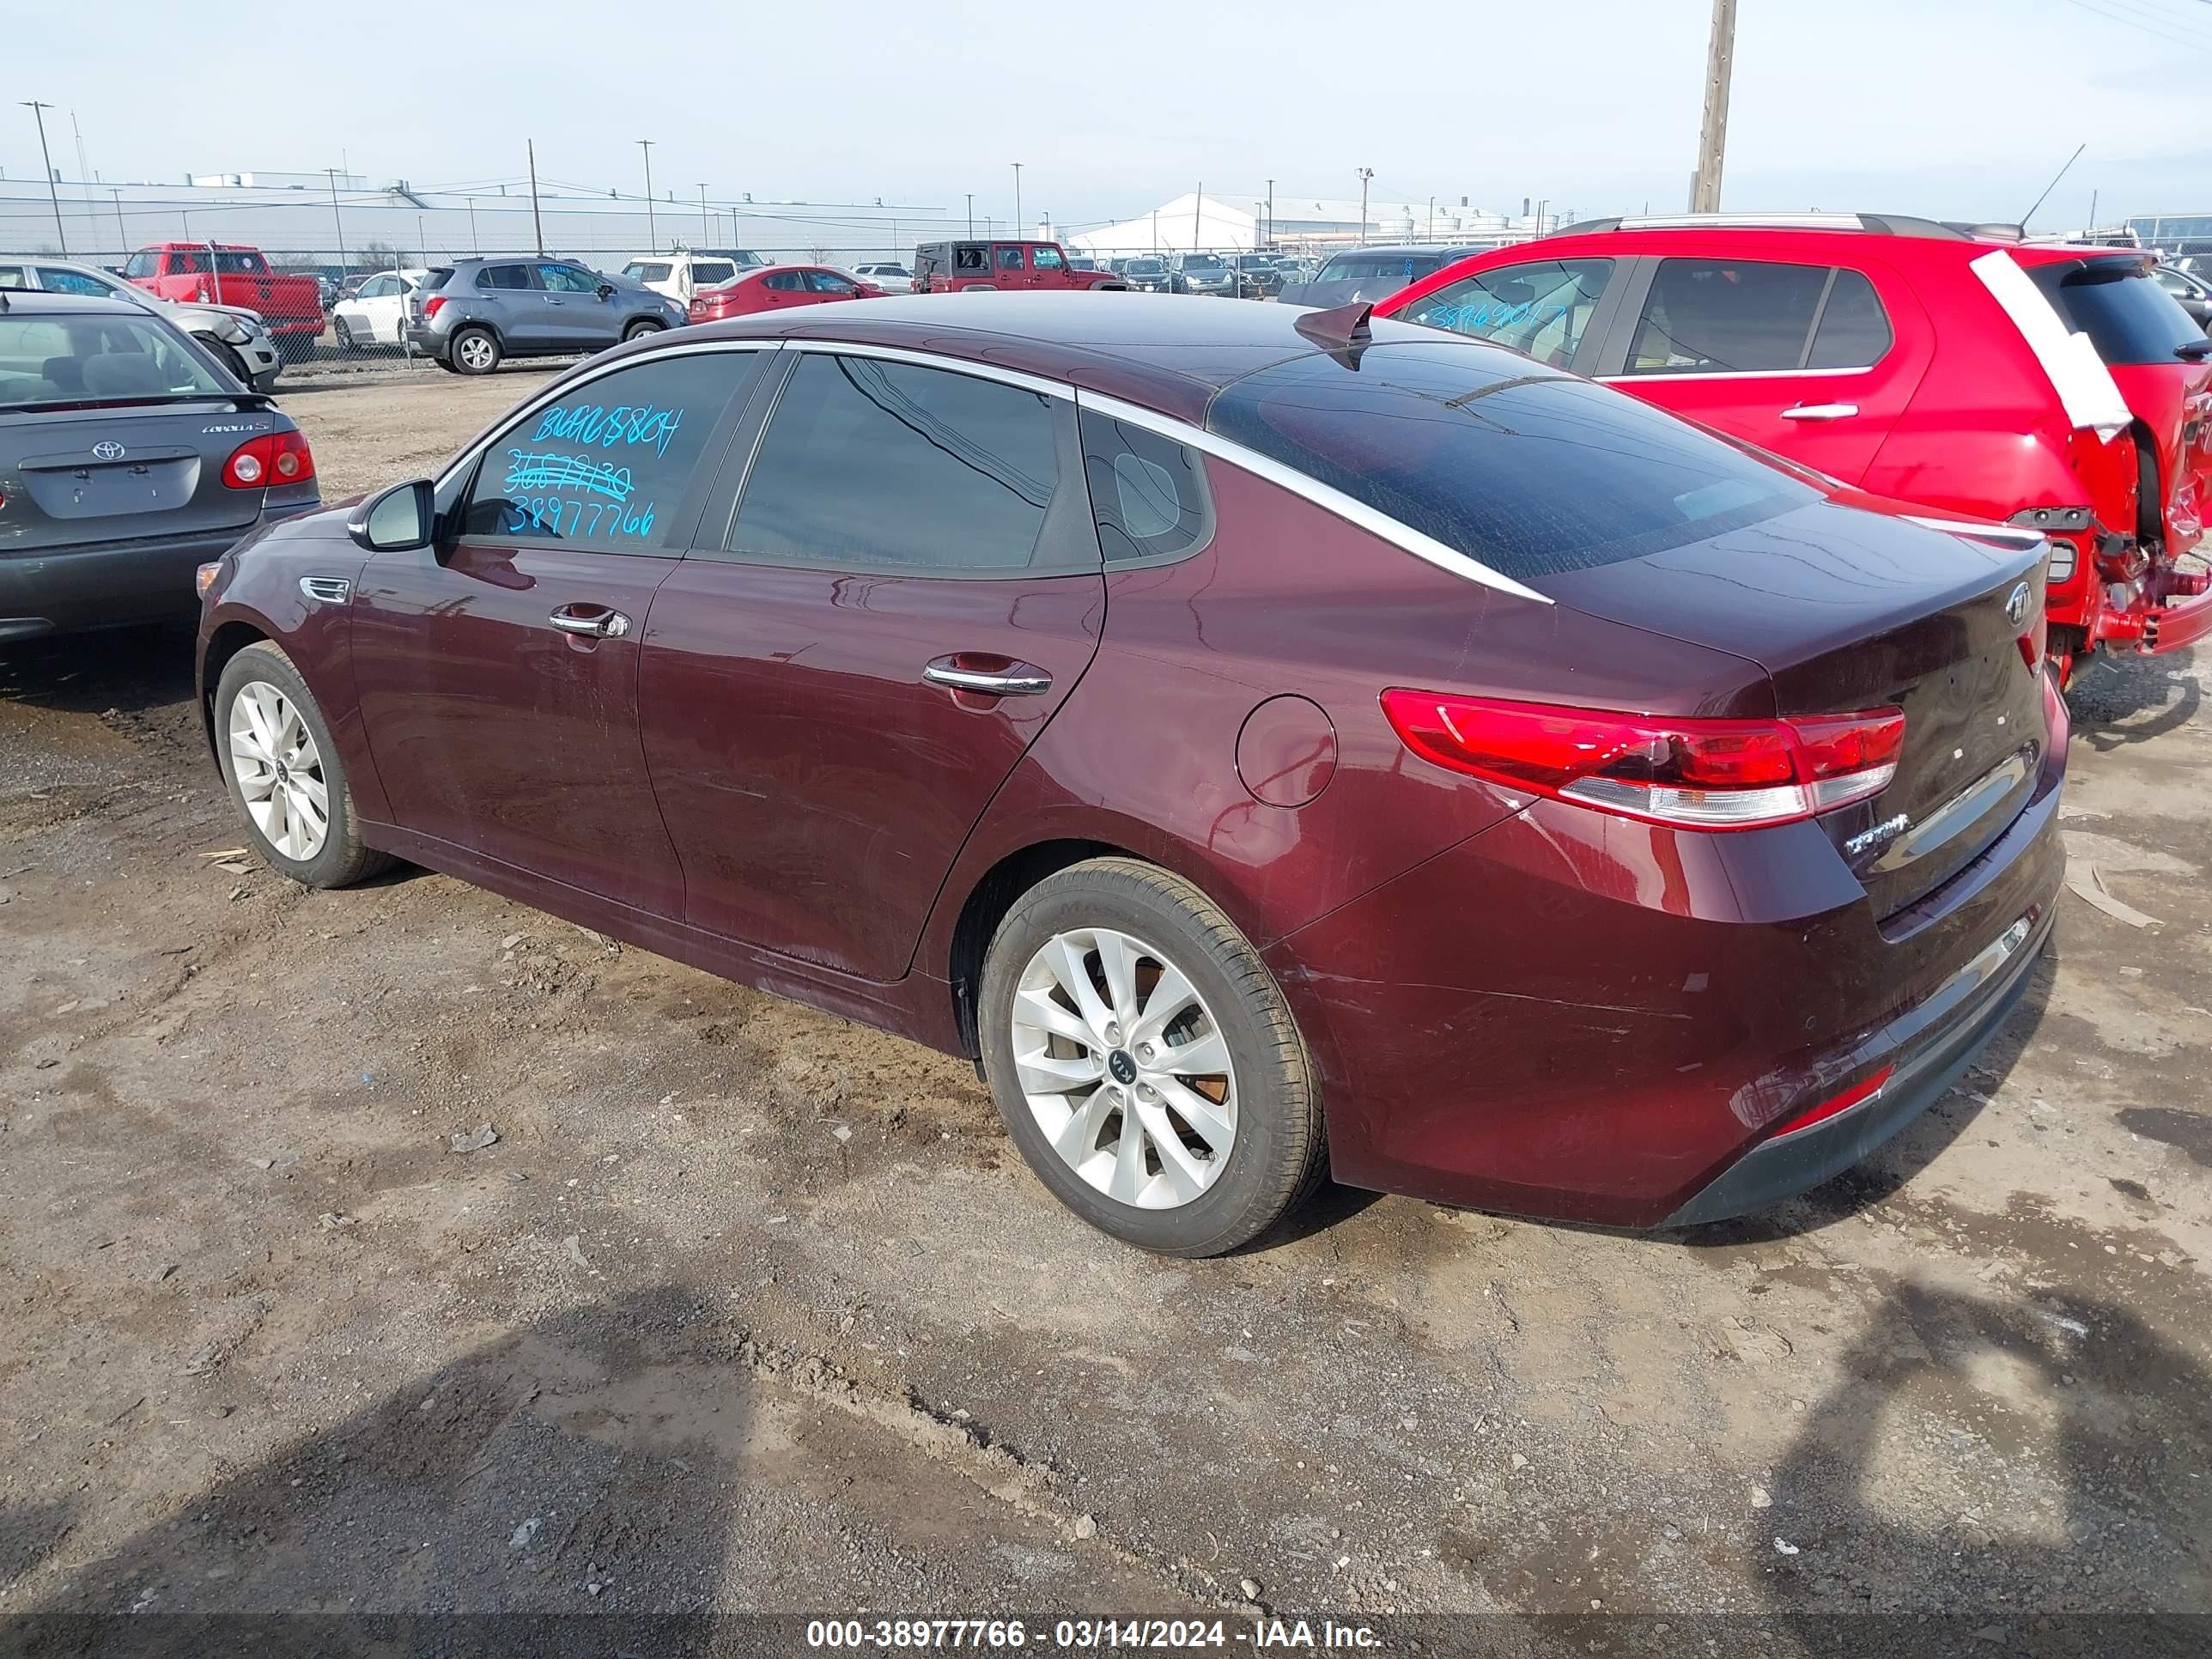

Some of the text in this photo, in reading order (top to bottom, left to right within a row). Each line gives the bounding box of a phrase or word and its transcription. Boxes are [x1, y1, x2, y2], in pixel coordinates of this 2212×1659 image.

[1431, 301, 1567, 334] 38969017
[508, 495, 655, 538] 38977766
[1112, 1052, 1133, 1083] KIA
